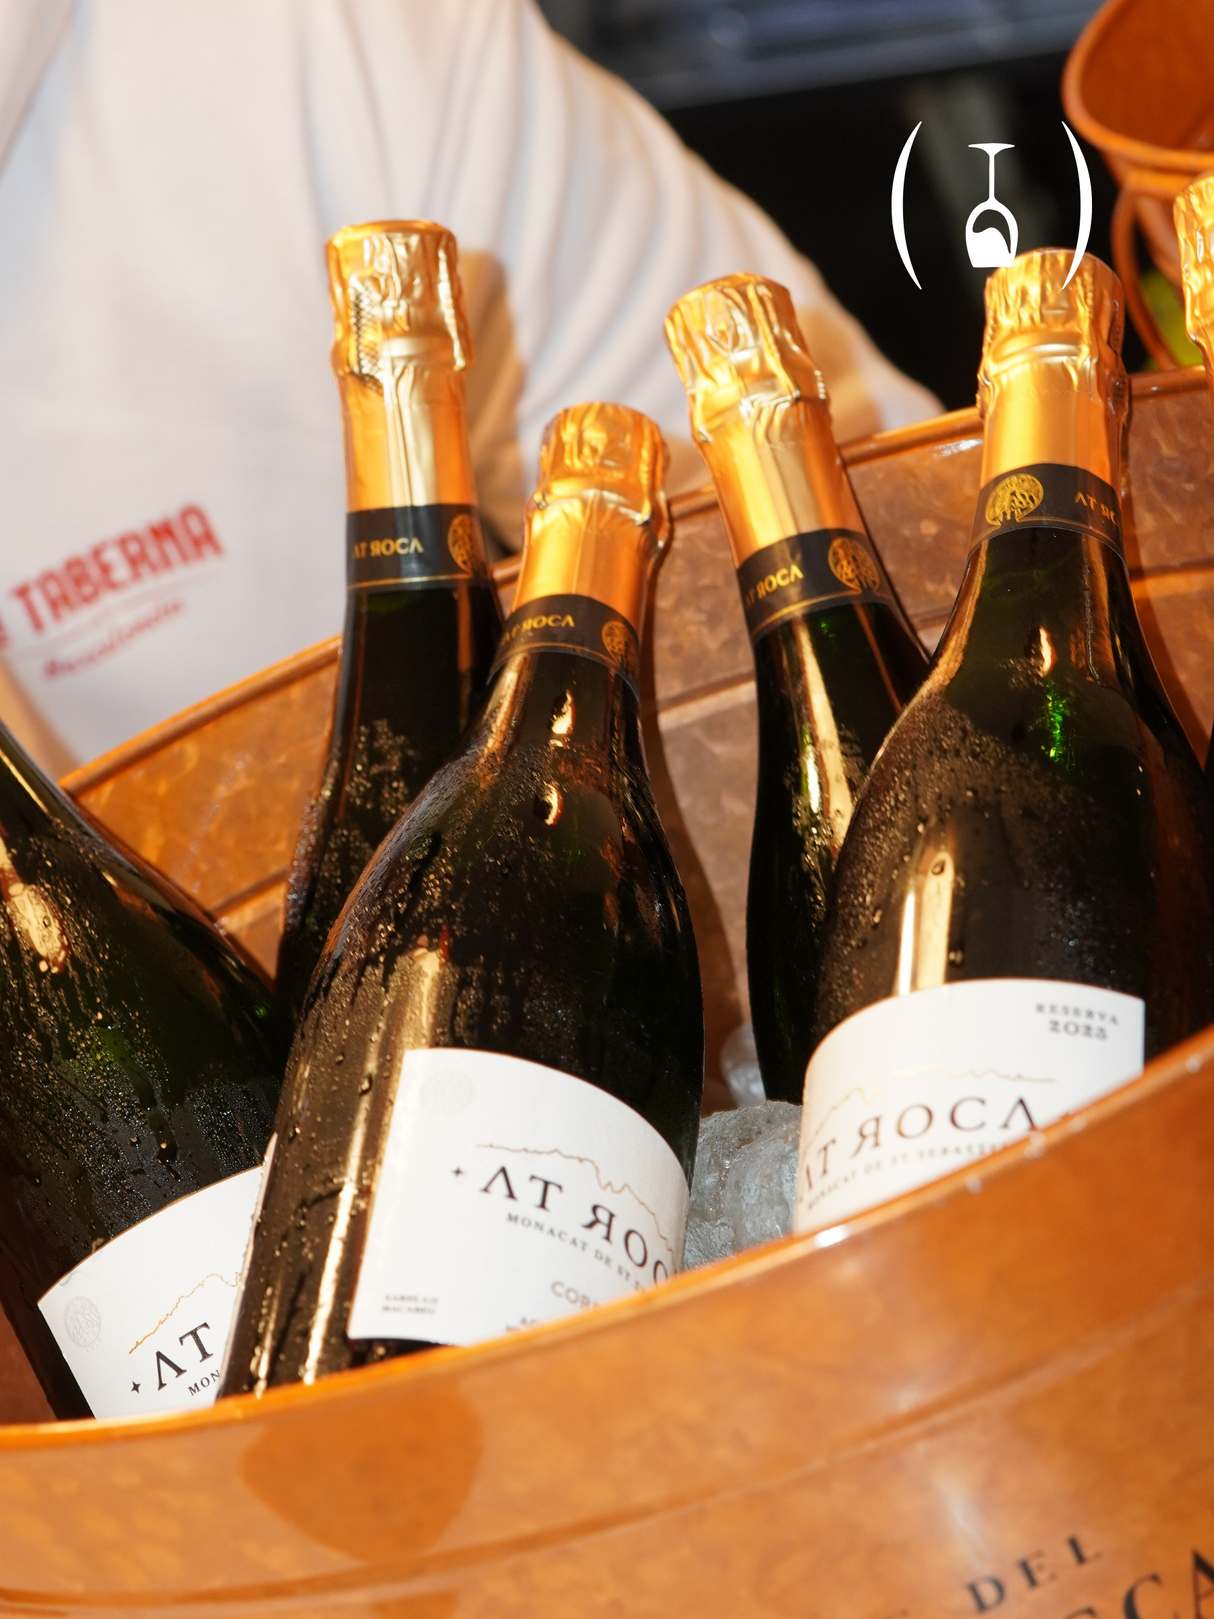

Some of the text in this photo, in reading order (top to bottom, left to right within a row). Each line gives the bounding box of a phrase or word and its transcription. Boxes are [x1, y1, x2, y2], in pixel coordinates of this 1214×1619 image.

[12, 503, 224, 636] TABERNA
[370, 537, 424, 557] ROCA
[756, 564, 804, 600] ROCA
[1035, 1002, 1120, 1026] RESERVA
[851, 1096, 1036, 1159] ROCA
[479, 1165, 563, 1212] AT
[506, 1212, 589, 1253] MONACAT
[594, 1248, 612, 1268] DE
[156, 1321, 214, 1391] AT
[188, 1369, 221, 1396] MON
[965, 1533, 1104, 1614] DEL
